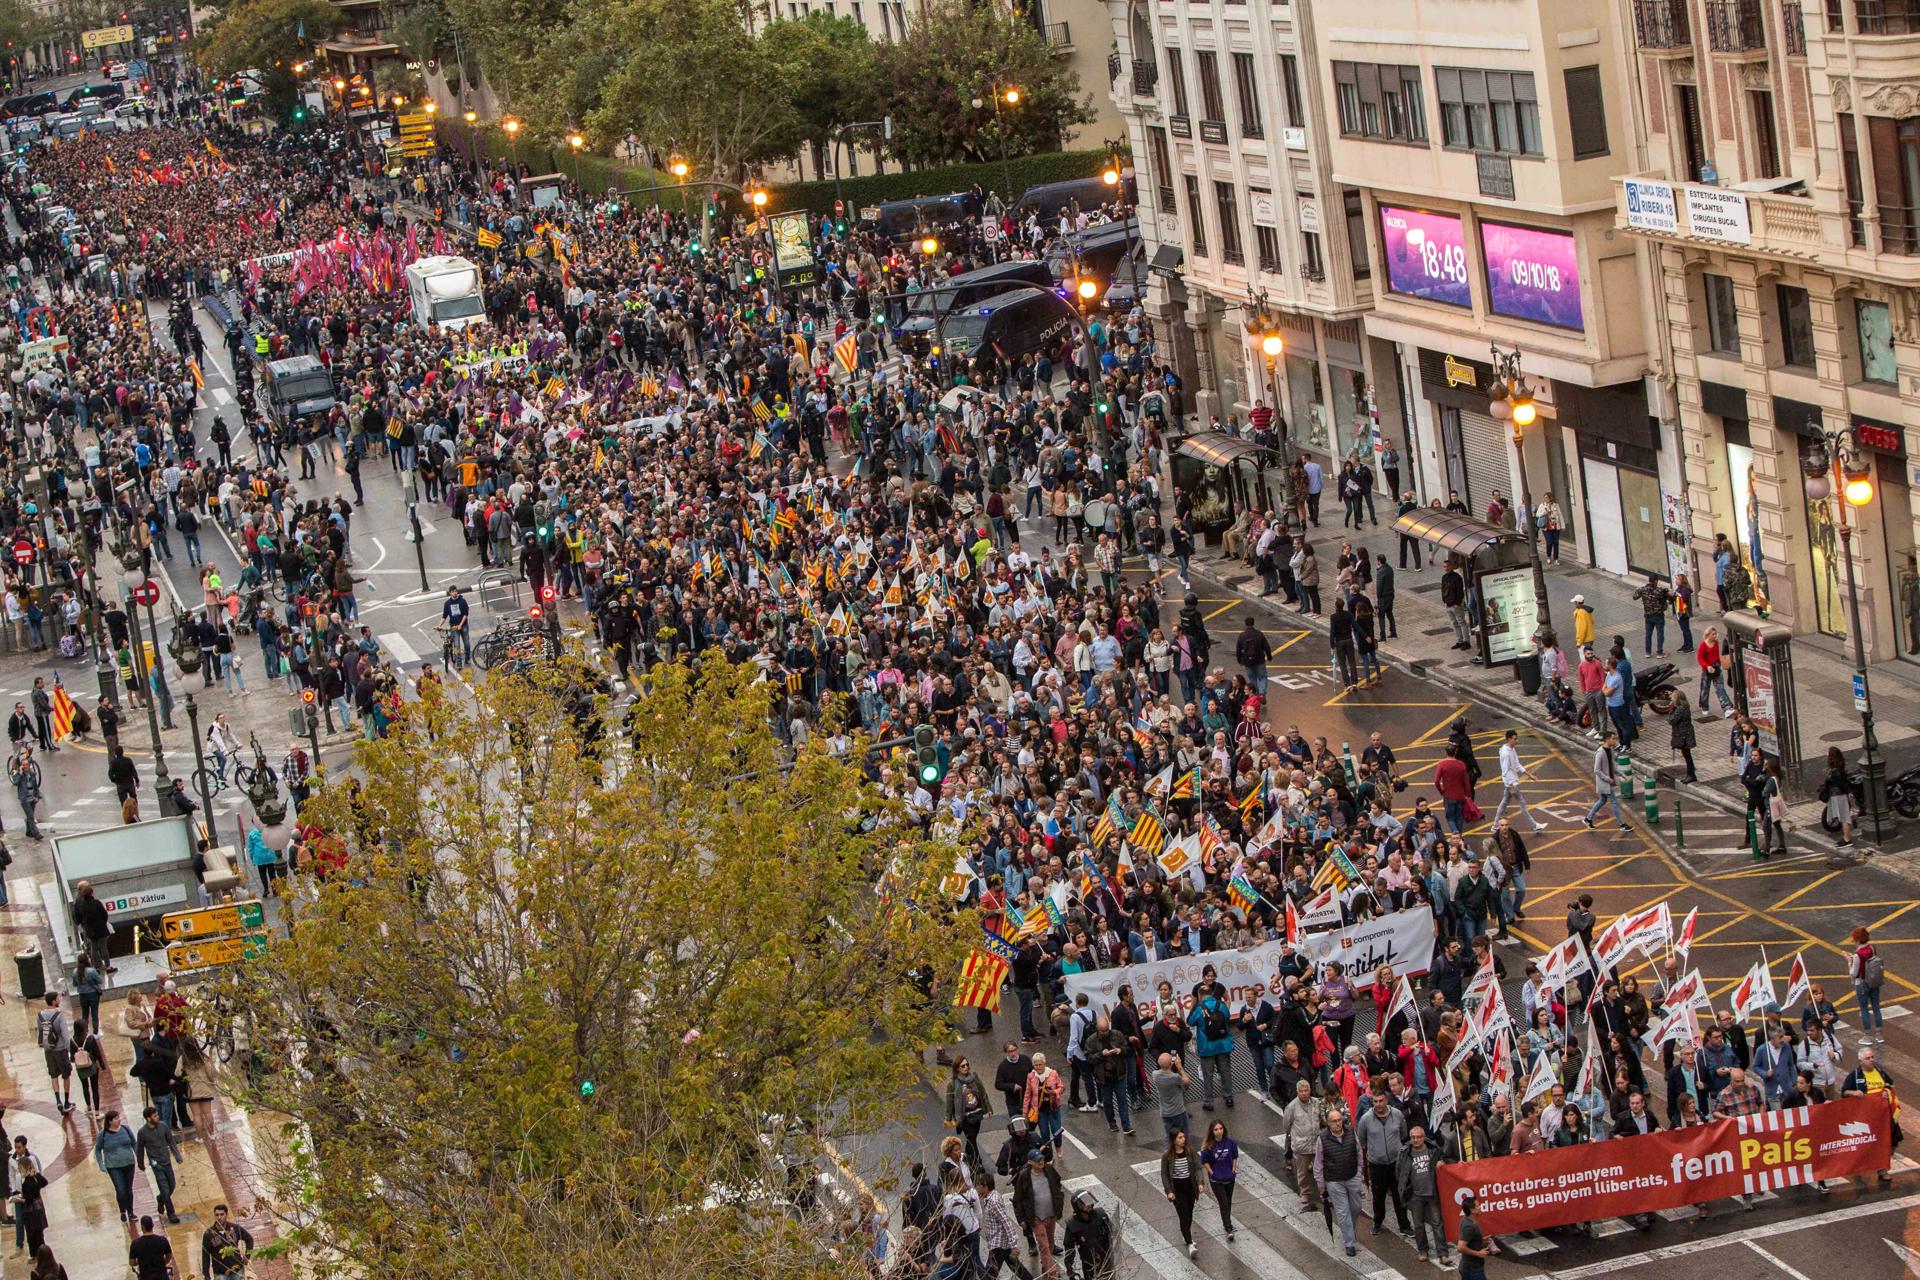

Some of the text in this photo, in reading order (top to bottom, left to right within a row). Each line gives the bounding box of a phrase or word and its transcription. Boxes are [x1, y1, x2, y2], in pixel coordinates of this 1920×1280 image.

[406, 60, 435, 70] MANO
[1655, 186, 1671, 198] DENTAL
[1689, 190, 1741, 204] ESTETICA DENTAL
[1641, 200, 1673, 216] RIBERA 18
[1691, 202, 1724, 213] IMPLANTES
[1693, 214, 1738, 227] CIRUGIA BUCAL
[1694, 226, 1723, 236] PROTESIS
[1420, 238, 1467, 284] 18:48
[1512, 259, 1560, 292] 09/10/18
[1858, 423, 1899, 450] GUESS
[1820, 1134, 1877, 1151] INTERSINDICAL
[1671, 1130, 1812, 1184] fem País
[1479, 1165, 1623, 1198] d'Octubre: guanyem
[1480, 1174, 1668, 1213] drets, guanyem llibertats,
